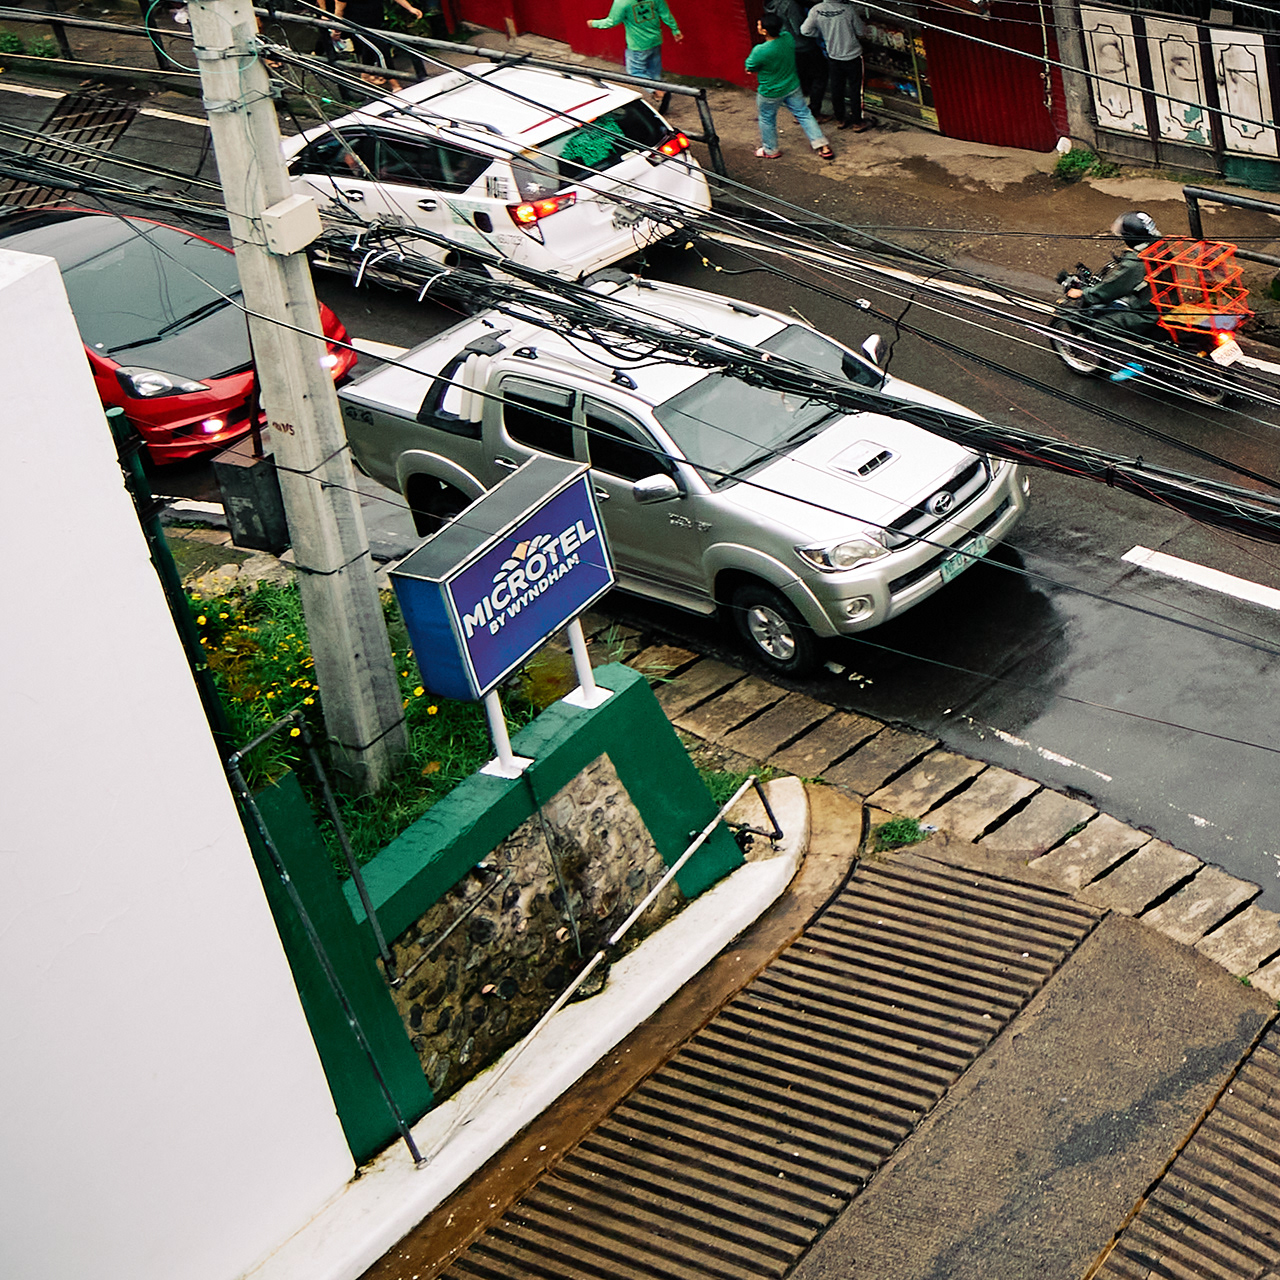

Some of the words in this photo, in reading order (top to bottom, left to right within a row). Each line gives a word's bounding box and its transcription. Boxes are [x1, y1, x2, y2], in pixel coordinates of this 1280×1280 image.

[462, 519, 596, 639] MICROTEL
[488, 612, 506, 636] BY
[506, 553, 580, 618] WYNDHAM
